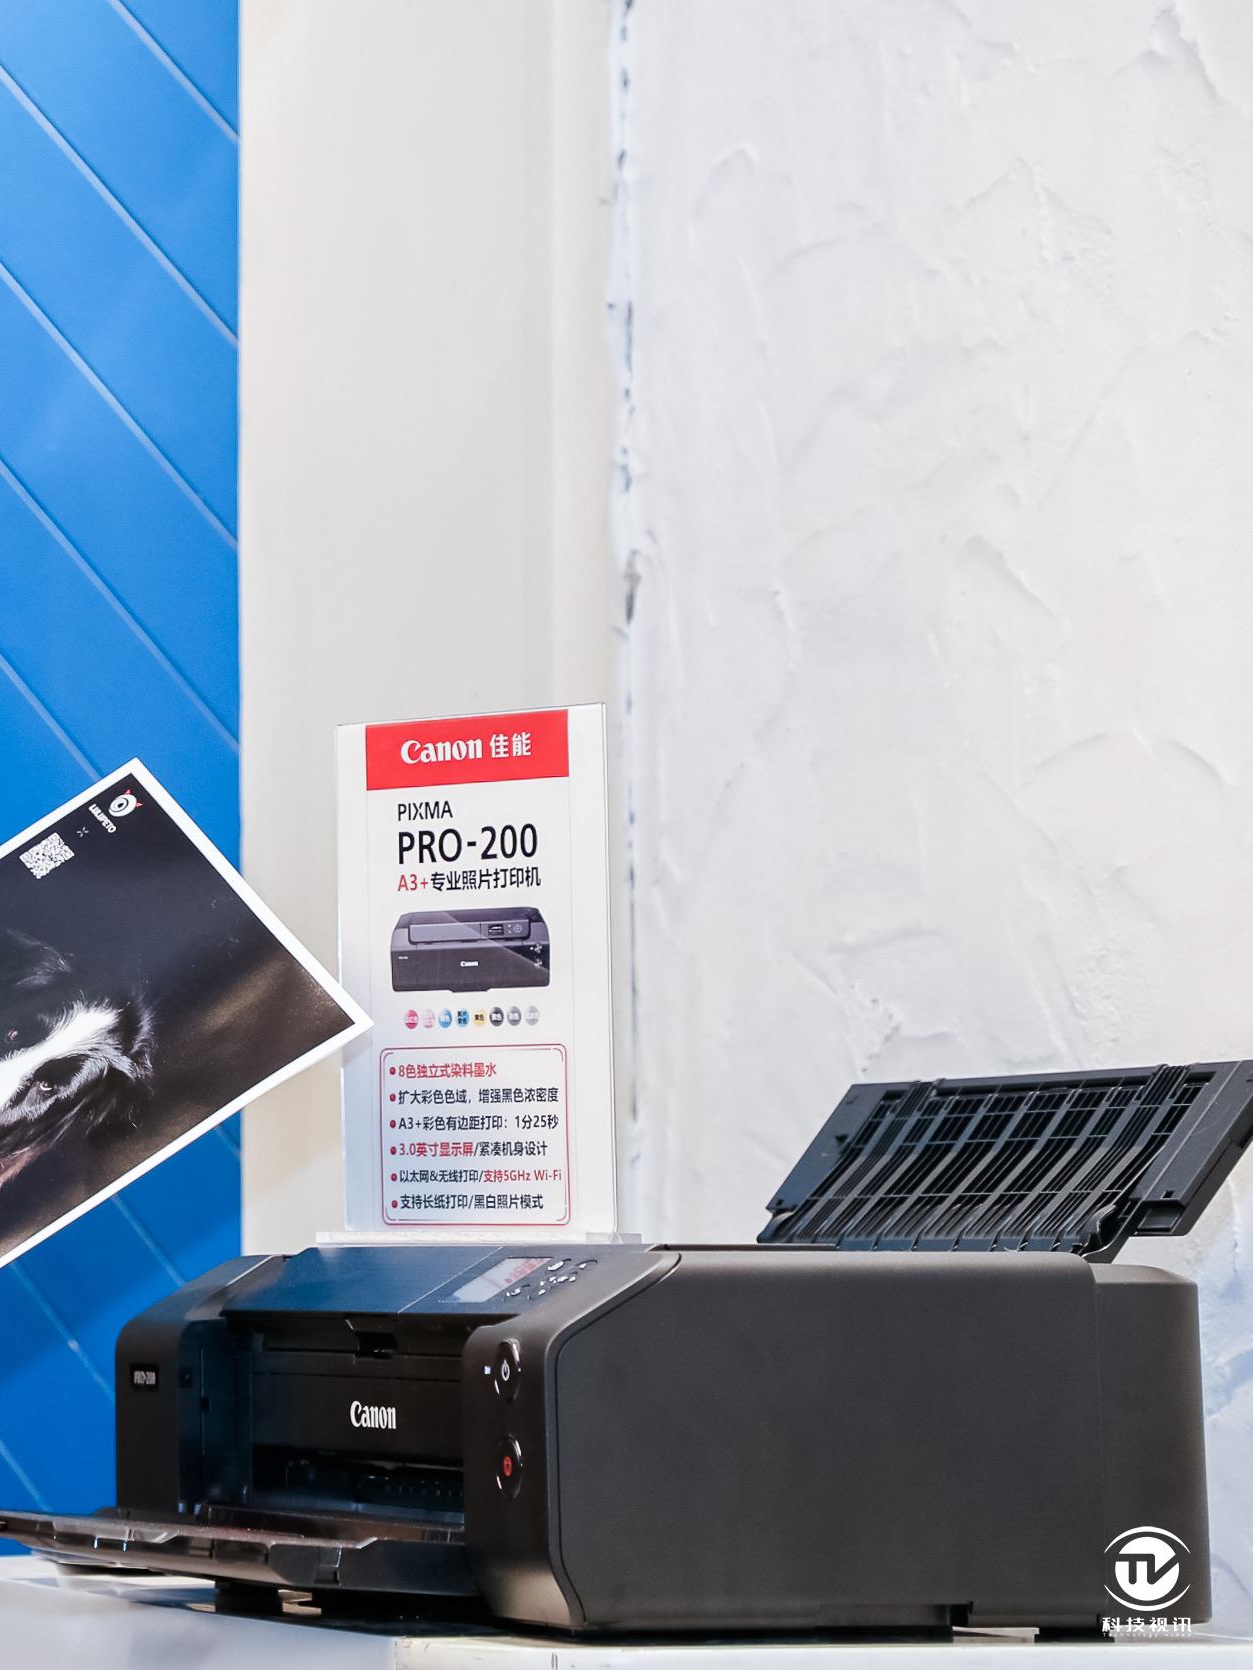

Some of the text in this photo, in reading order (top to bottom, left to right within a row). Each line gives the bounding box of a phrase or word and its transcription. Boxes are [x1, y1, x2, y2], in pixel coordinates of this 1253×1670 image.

[400, 732, 532, 764] Canon 佳能
[397, 801, 453, 821] PIXMA
[398, 823, 538, 864] PRO-200
[397, 866, 541, 892] A3+专业照片打印机
[398, 1062, 497, 1078] 8色独立式染料墨水
[398, 1087, 559, 1104] 扩大彩色色域，增强黑色浓密度
[399, 1141, 548, 1157] 3.0英寸显示屏/紧凑机身设计
[399, 1169, 562, 1183] 以太网&无线打印/支持5GHz Wi-Fi
[400, 1194, 544, 1210] 支持长纸打印/黑白照片模式
[350, 1400, 397, 1430] Canon
